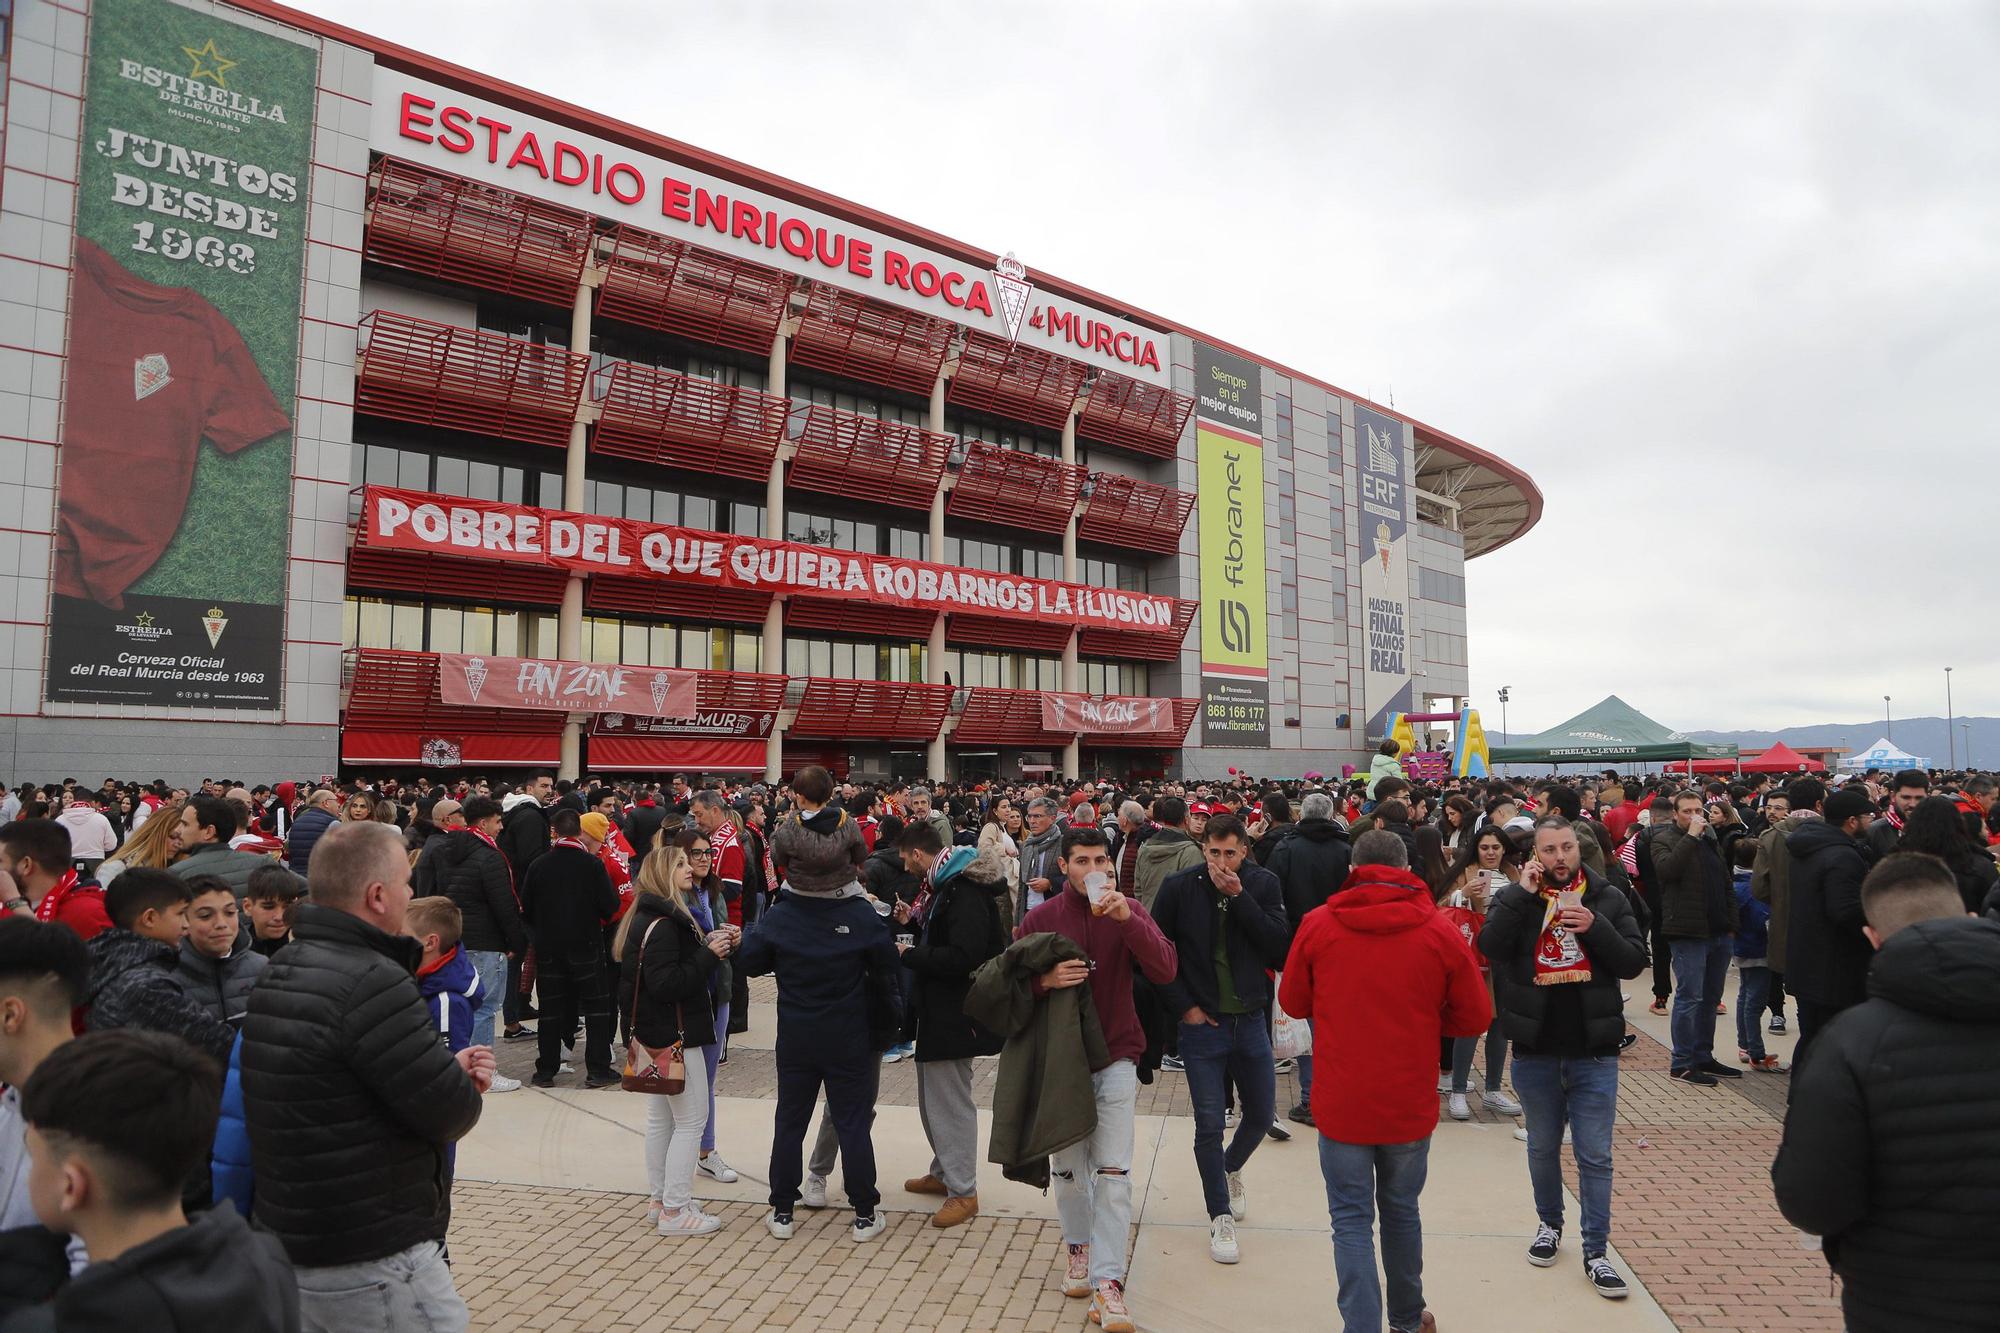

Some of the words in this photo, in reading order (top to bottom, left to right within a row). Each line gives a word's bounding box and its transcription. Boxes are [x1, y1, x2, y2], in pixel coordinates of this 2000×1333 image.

[119, 58, 287, 124] ESTRELLA
[160, 90, 181, 104] DE
[183, 97, 251, 124] LEVANTE
[168, 108, 214, 126] MURCIA
[96, 128, 297, 203] JUNTOS
[111, 172, 278, 240] DESDE
[399, 92, 646, 205] ESTADIO
[661, 176, 872, 279] ENRIQUE
[884, 250, 994, 317] ROCA
[1028, 305, 1045, 330] de
[1048, 306, 1161, 372] MURCIA
[132, 220, 255, 274] 1963
[1002, 279, 1024, 291] MURCIA
[1212, 366, 1247, 390] Siempre
[1219, 388, 1230, 399] en
[1232, 390, 1239, 402] el
[1201, 395, 1226, 412] mejor
[1228, 405, 1257, 422] equipo
[1362, 473, 1400, 504] ERF
[1224, 450, 1244, 588] fibranet
[1366, 503, 1398, 519] INTERNATIONAL
[378, 498, 542, 554] POBRE
[550, 520, 630, 566] DEL
[641, 533, 723, 578] QUE
[730, 544, 869, 592] QUIERA
[872, 563, 1034, 614] ROBARNOS
[1038, 584, 1073, 616] LA
[1369, 597, 1394, 614] HASTA
[1396, 602, 1403, 616] EL
[116, 624, 172, 636] ESTRELLA
[1370, 612, 1404, 636] FINAL
[1370, 632, 1404, 652] VAMOS
[118, 652, 176, 666] Cerveza
[180, 655, 225, 669] Oficial
[1371, 648, 1405, 674] REAL
[70, 664, 95, 675] del
[98, 665, 130, 677] Real
[135, 667, 184, 680] Murcia
[187, 670, 229, 682] desde
[234, 672, 265, 684] 1963
[517, 662, 562, 699] FAN
[563, 665, 634, 702] ZONE
[1208, 704, 1225, 717] 868
[1229, 706, 1246, 718] 166
[1249, 706, 1264, 719] 177
[1208, 720, 1265, 731] www.fibranet.tv
